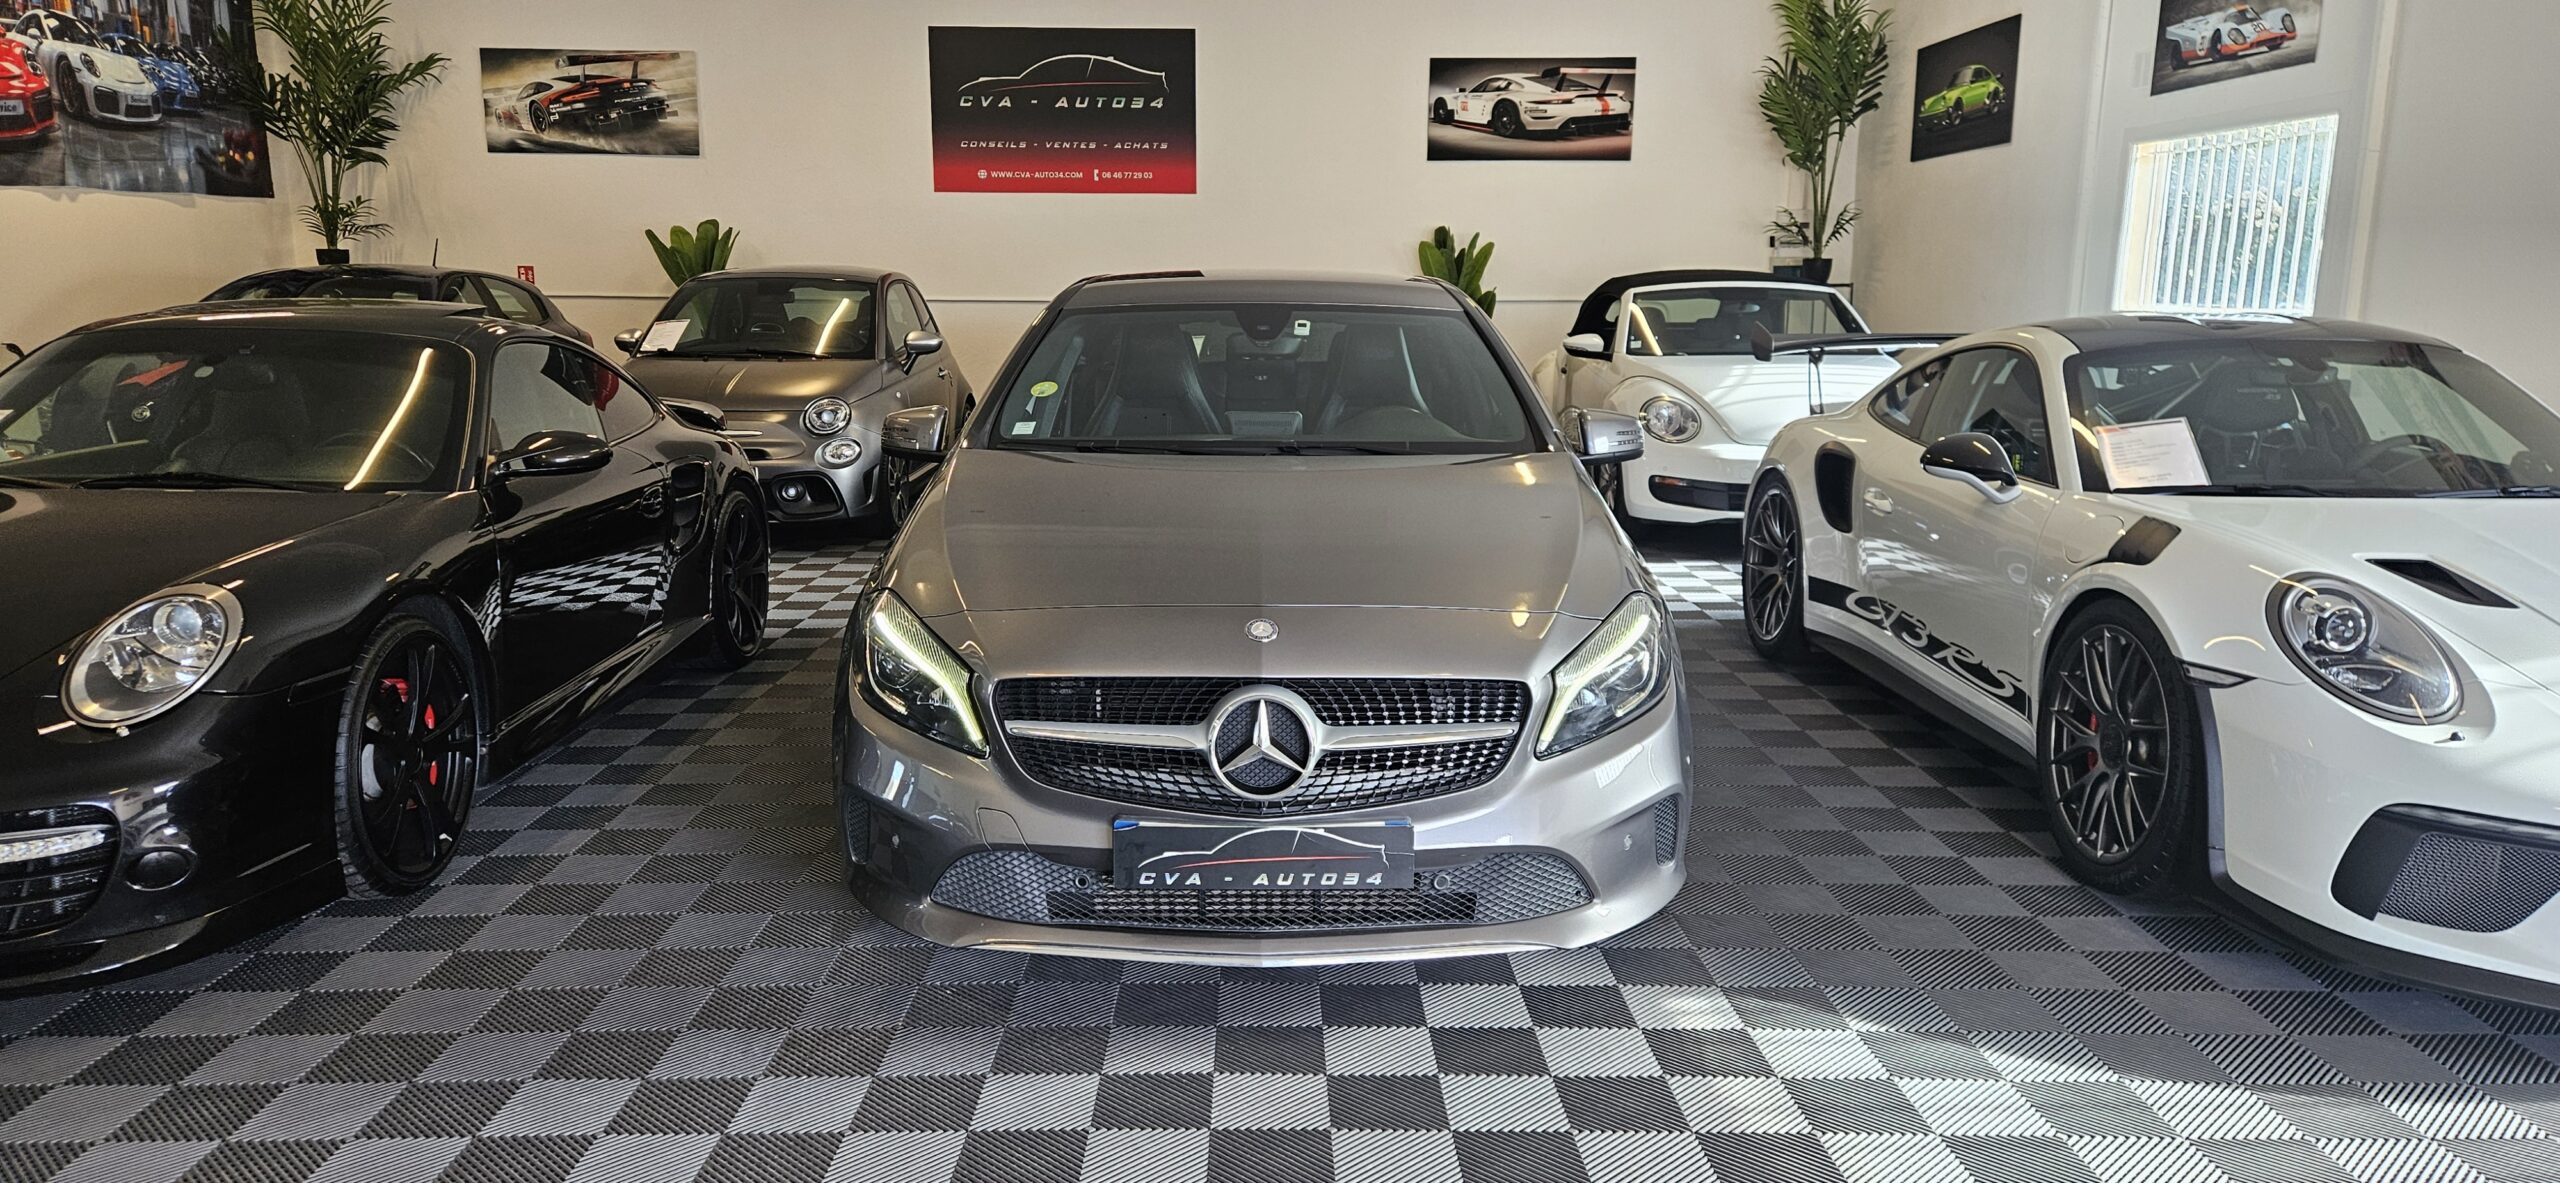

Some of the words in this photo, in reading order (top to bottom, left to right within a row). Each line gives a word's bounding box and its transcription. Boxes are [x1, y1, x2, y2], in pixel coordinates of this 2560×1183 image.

[959, 95, 1012, 108] CVA
[1054, 96, 1164, 109] AUTO34
[960, 140, 1027, 149] CONSEILS
[1045, 141, 1097, 149] VENTES
[1113, 141, 1169, 150] ACHATS
[990, 171, 1083, 179] WWW.CVA-AUTO34.COM
[1123, 171, 1133, 179] 77
[1845, 591, 1931, 648] GT3
[1932, 640, 2023, 698] RS
[1138, 872, 1202, 886] CVA
[1252, 872, 1384, 886] AUTO34
